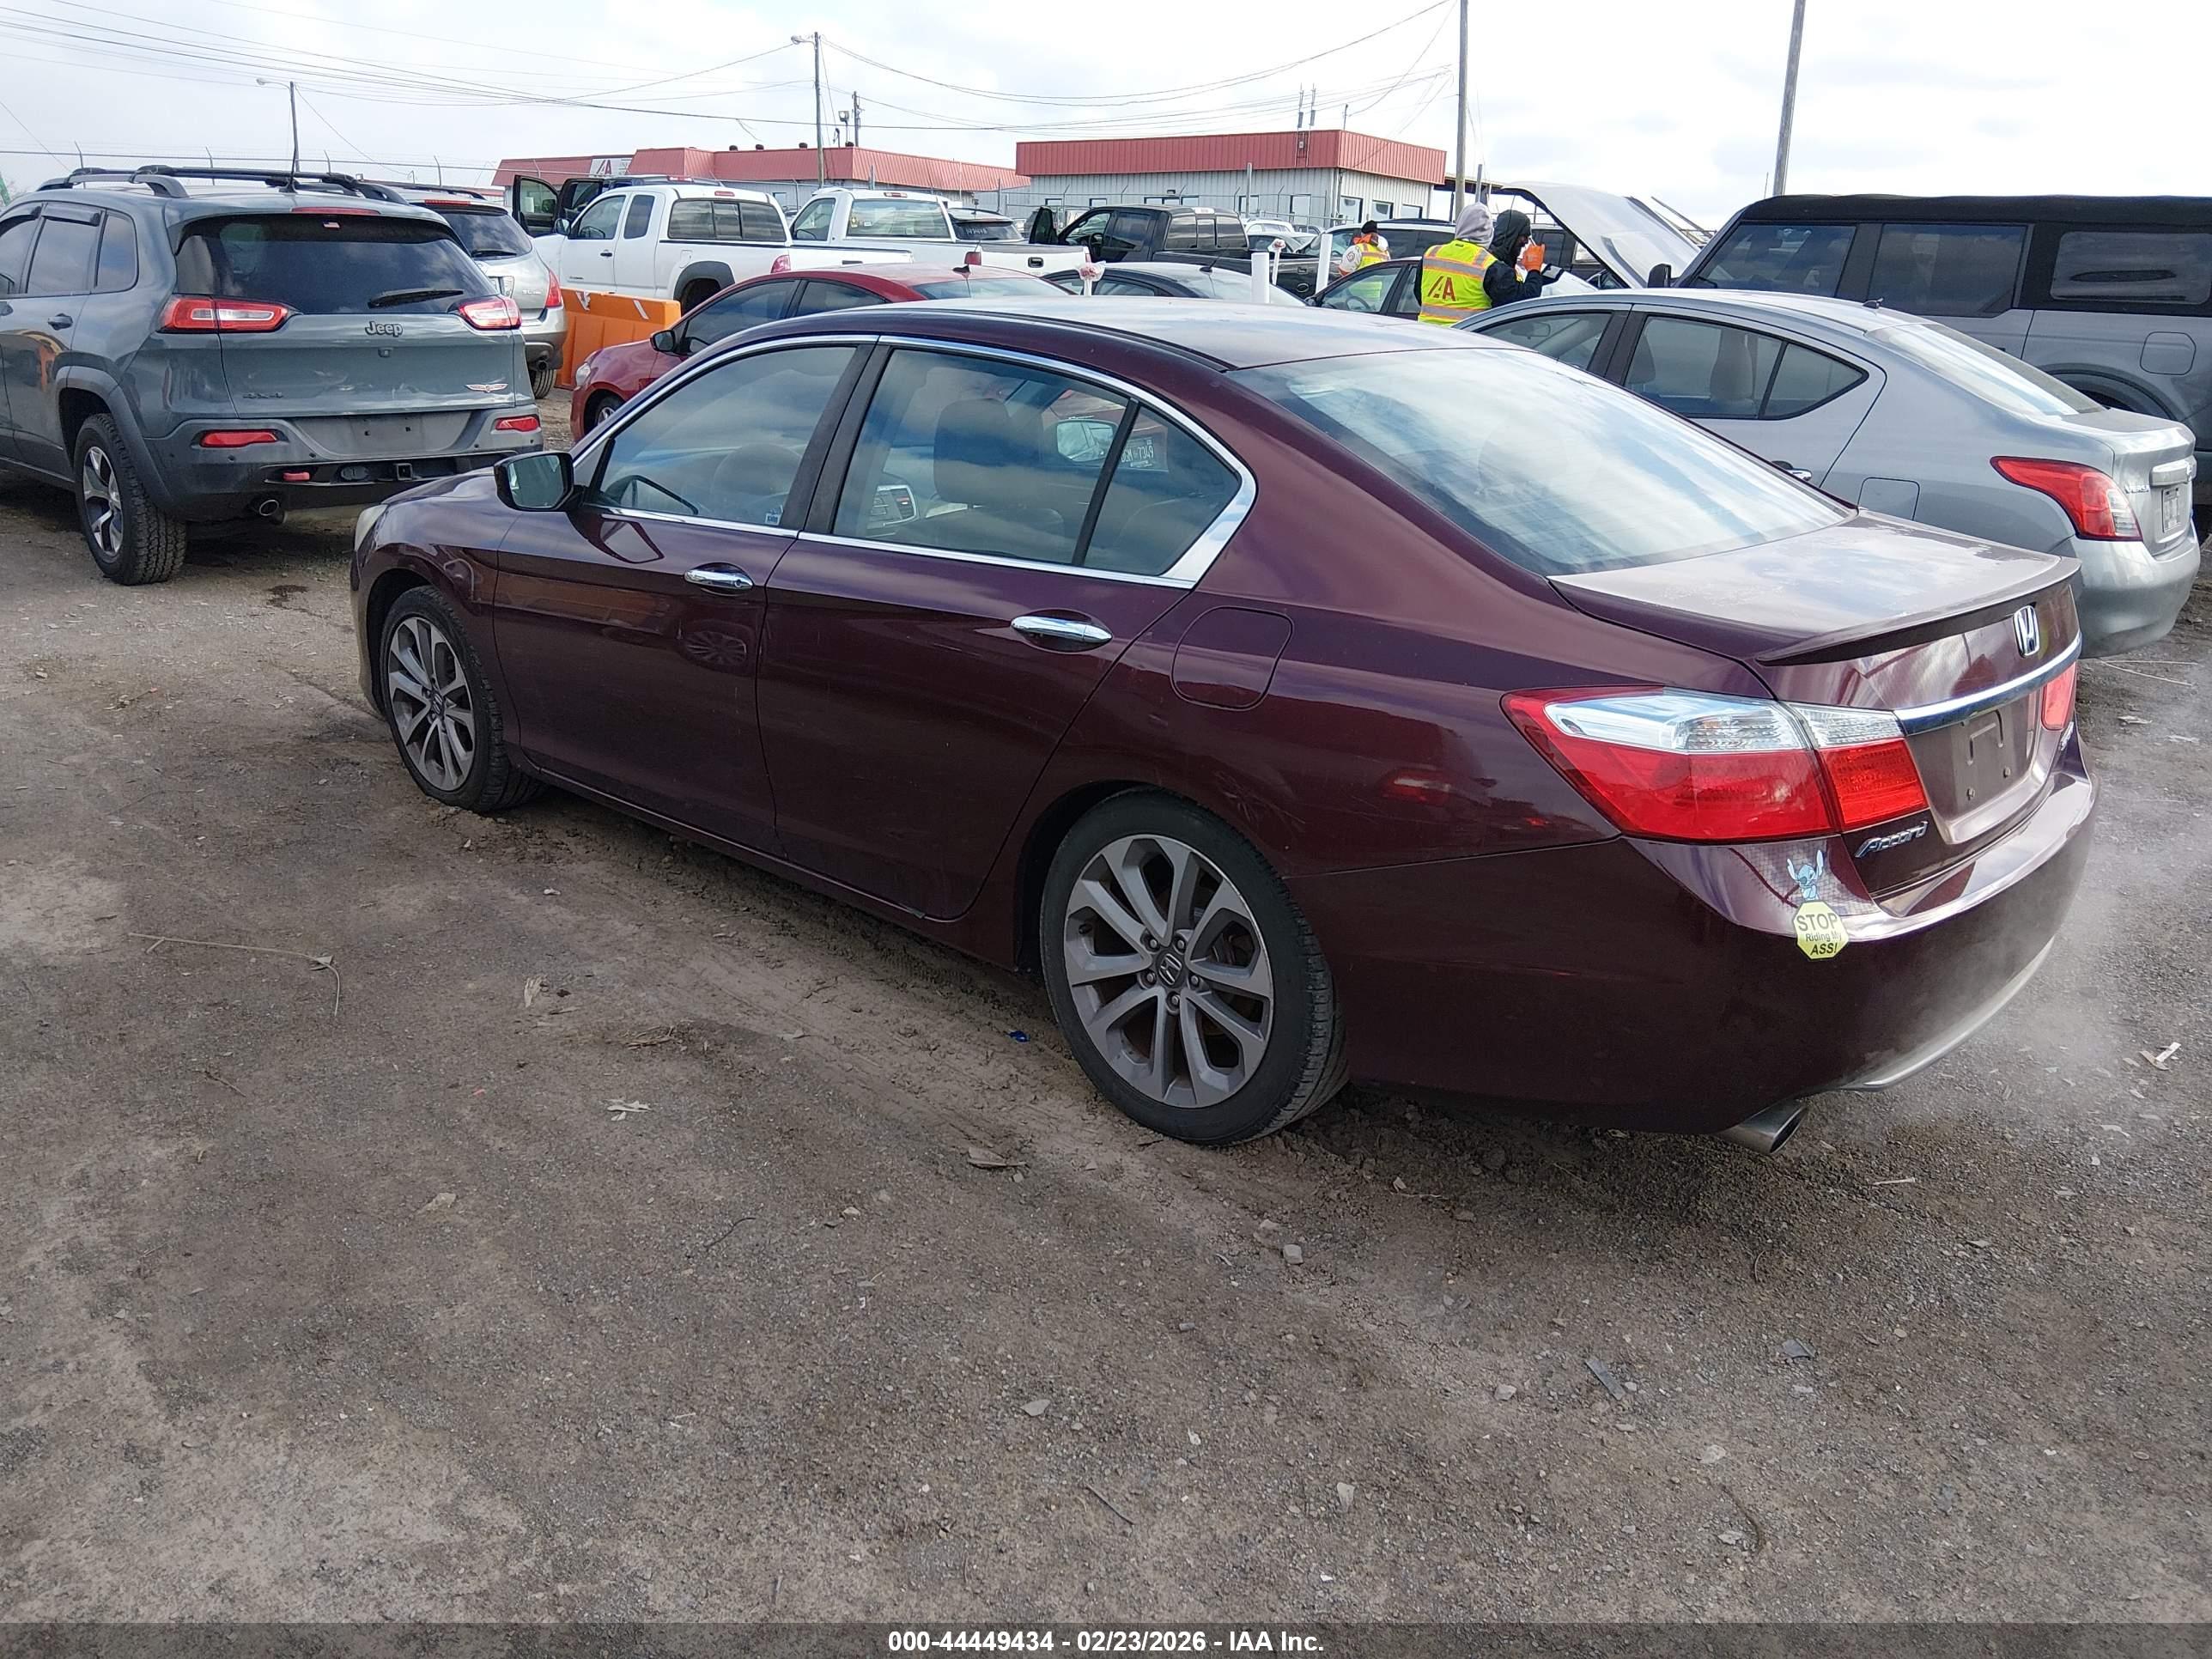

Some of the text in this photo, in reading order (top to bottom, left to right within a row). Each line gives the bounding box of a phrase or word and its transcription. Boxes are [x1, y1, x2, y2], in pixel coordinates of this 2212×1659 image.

[364, 320, 404, 337] Jeep
[1855, 820, 1929, 858] Accord
[1796, 912, 1838, 932] STOP
[1805, 932, 1831, 942] Riding
[1810, 942, 1838, 956] ASS!
